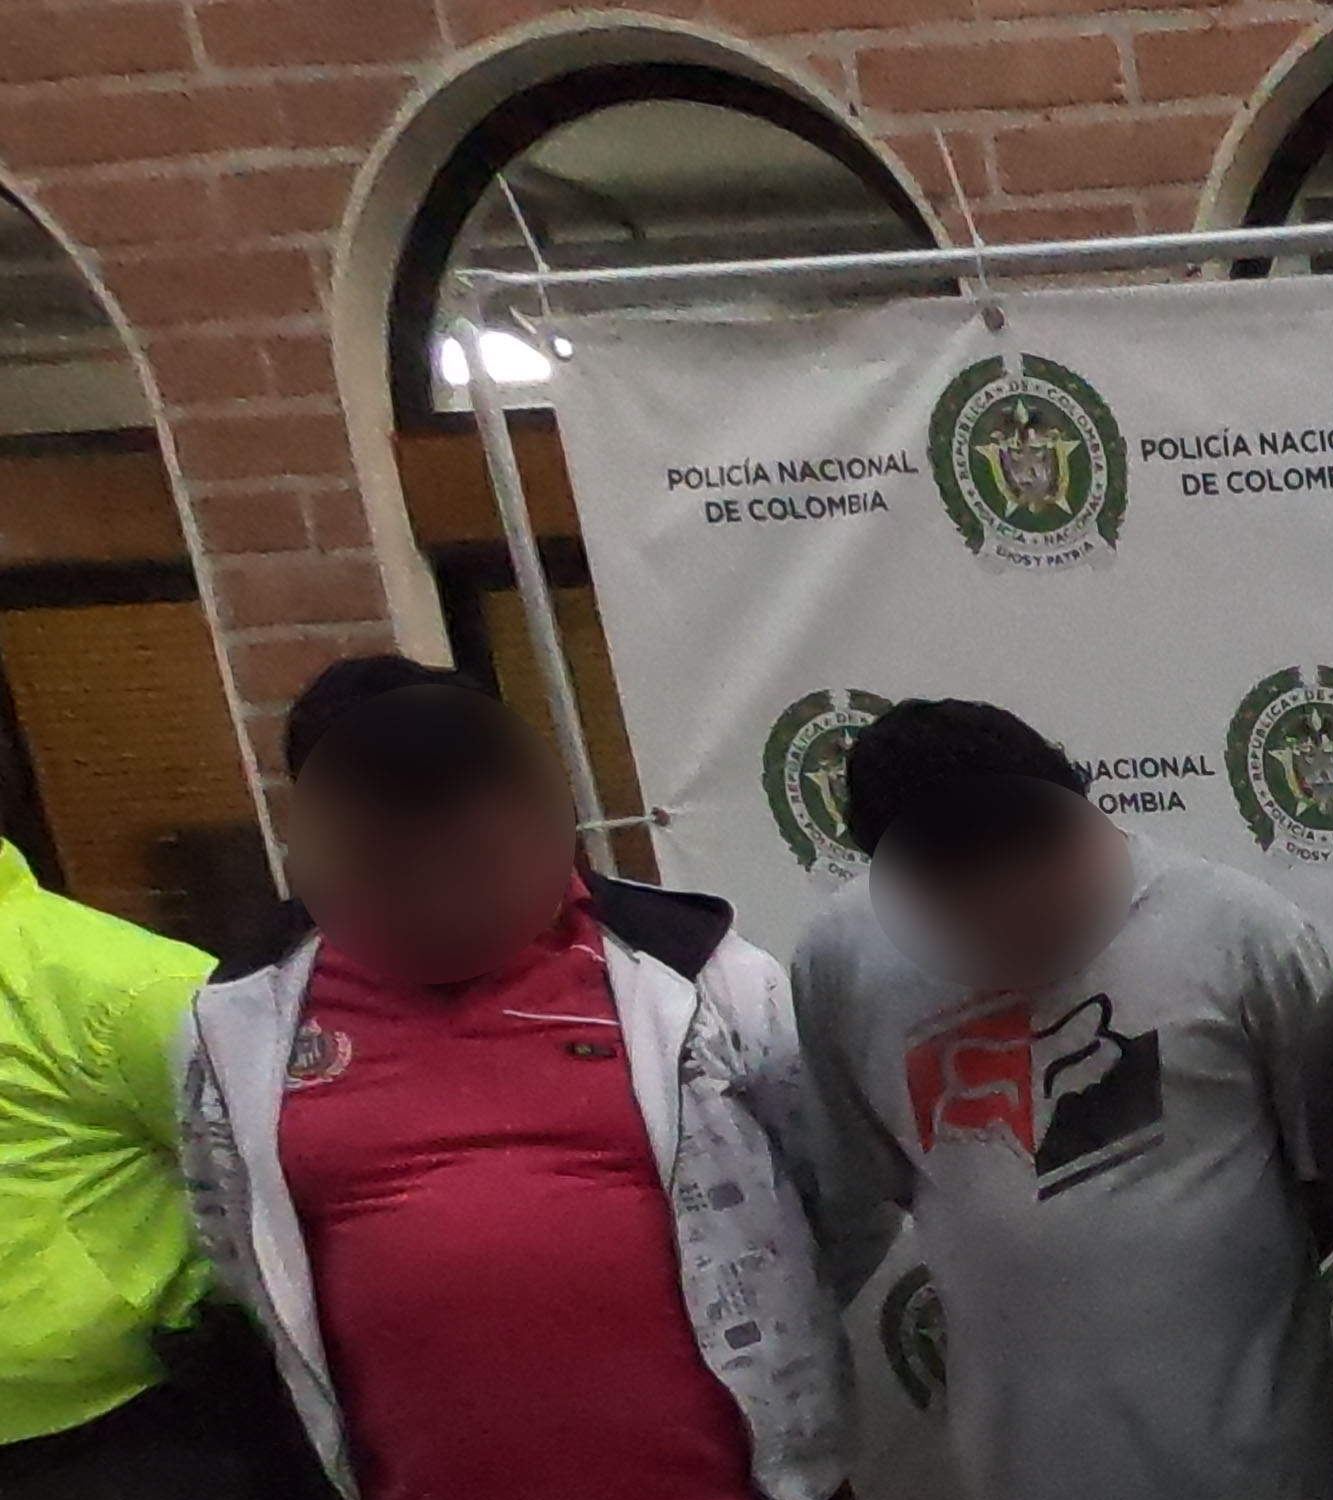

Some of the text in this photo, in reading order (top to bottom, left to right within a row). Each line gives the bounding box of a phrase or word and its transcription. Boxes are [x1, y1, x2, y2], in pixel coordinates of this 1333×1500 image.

[1141, 428, 1250, 462] POLICÍA
[667, 452, 918, 491] POLICÍA NACIONAL
[1182, 474, 1219, 496] DE
[705, 492, 888, 523] DE COLOMBIA
[1098, 790, 1186, 814] OMBIA
